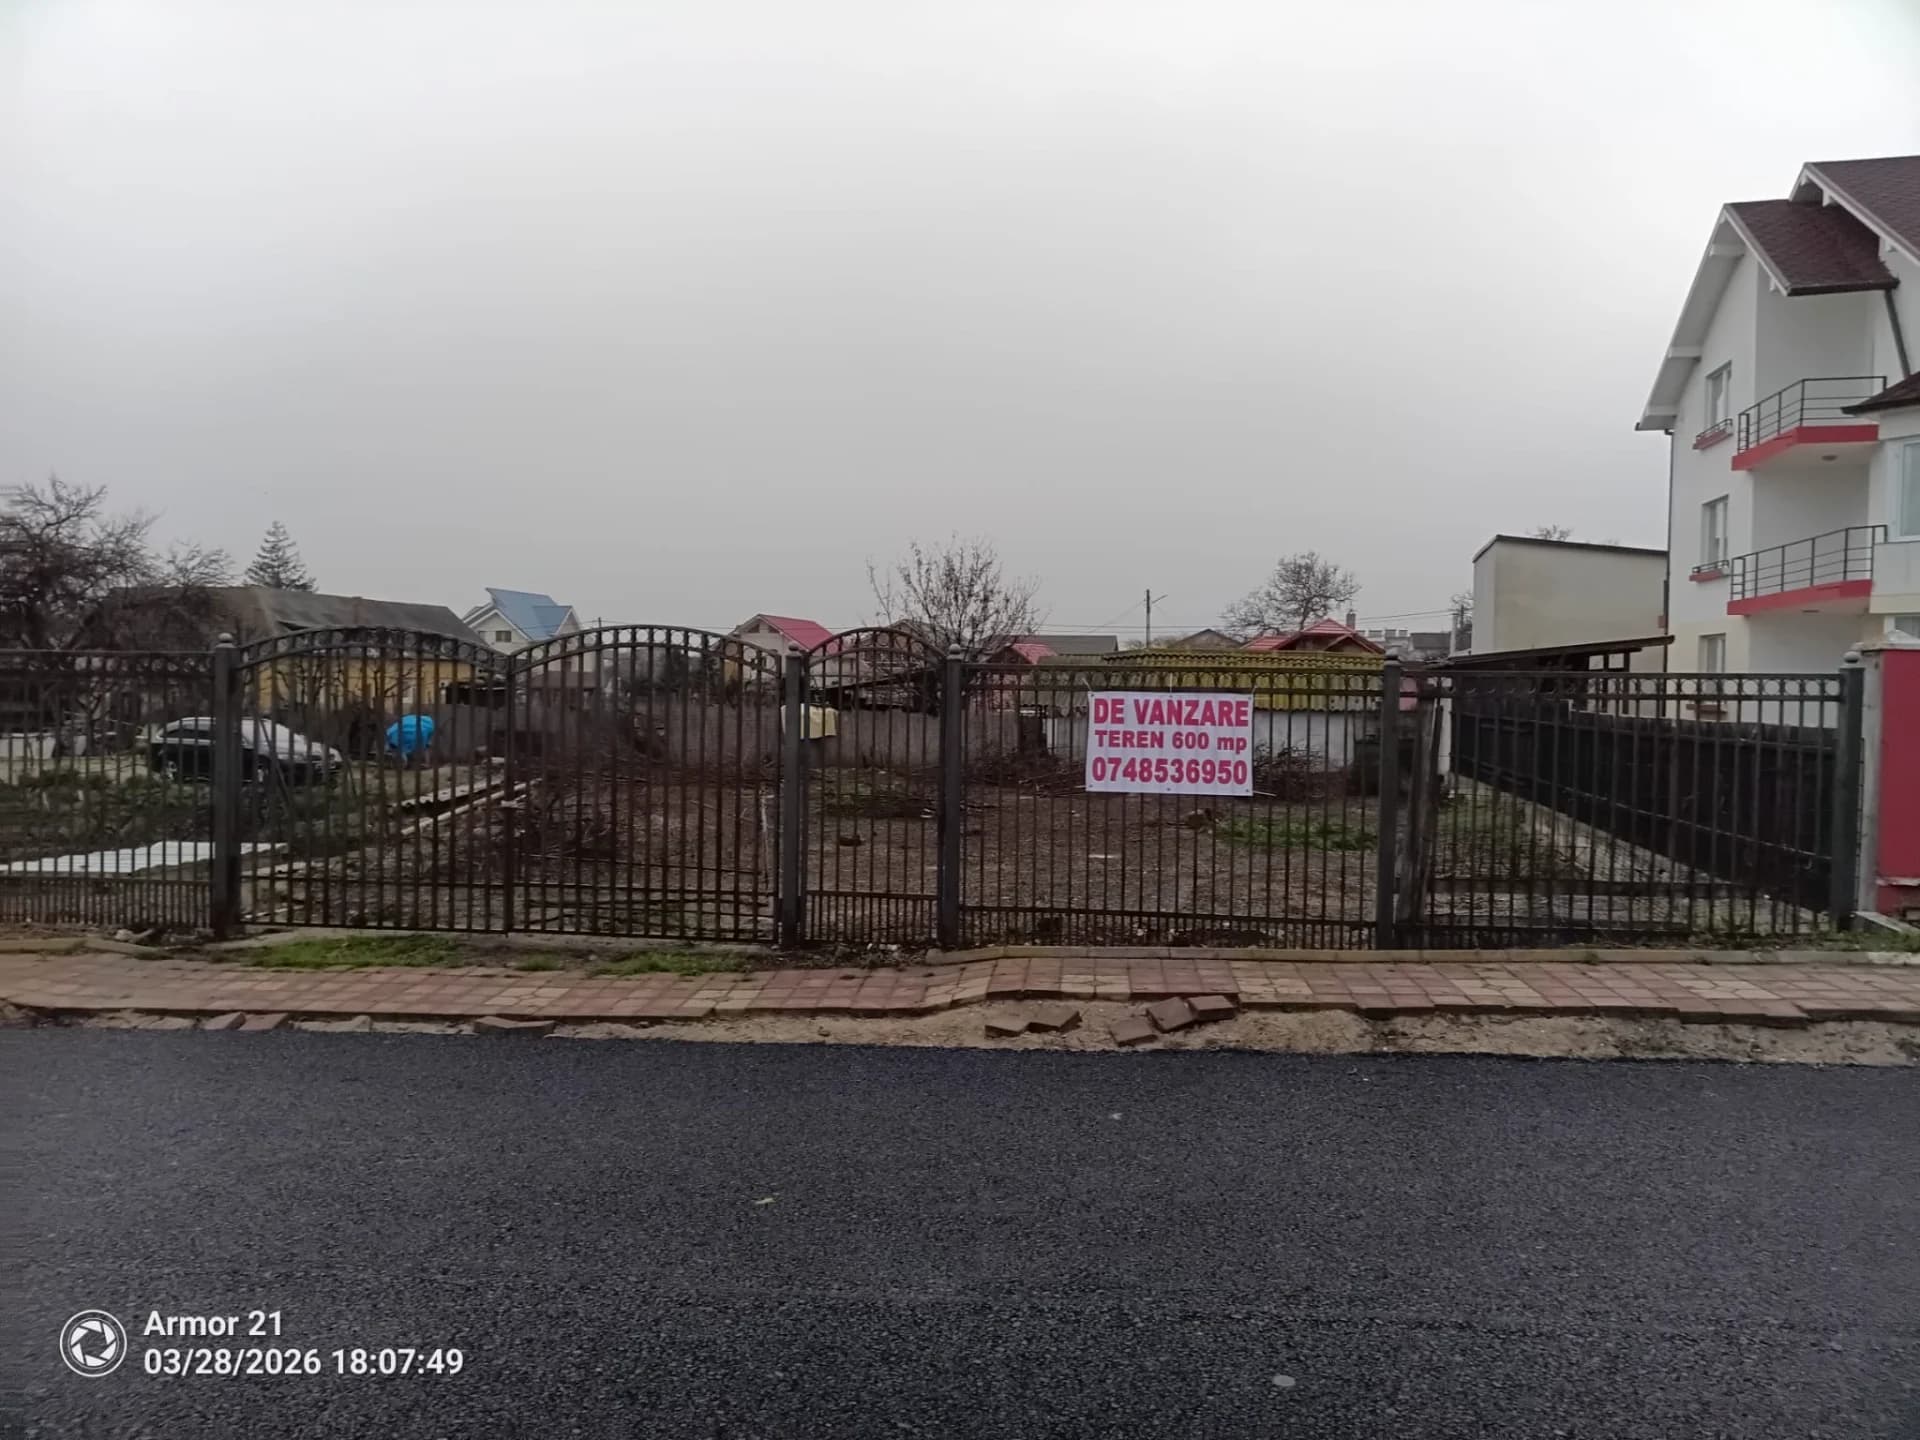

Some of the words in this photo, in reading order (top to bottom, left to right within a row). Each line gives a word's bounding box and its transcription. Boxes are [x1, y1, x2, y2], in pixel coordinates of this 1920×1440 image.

[1094, 698, 1125, 725] DE
[1133, 699, 1249, 727] VANZARE
[1094, 730, 1164, 749] TEREN
[1172, 731, 1209, 750] 600
[1216, 736, 1247, 754] mp
[1092, 756, 1248, 785] 0748536950
